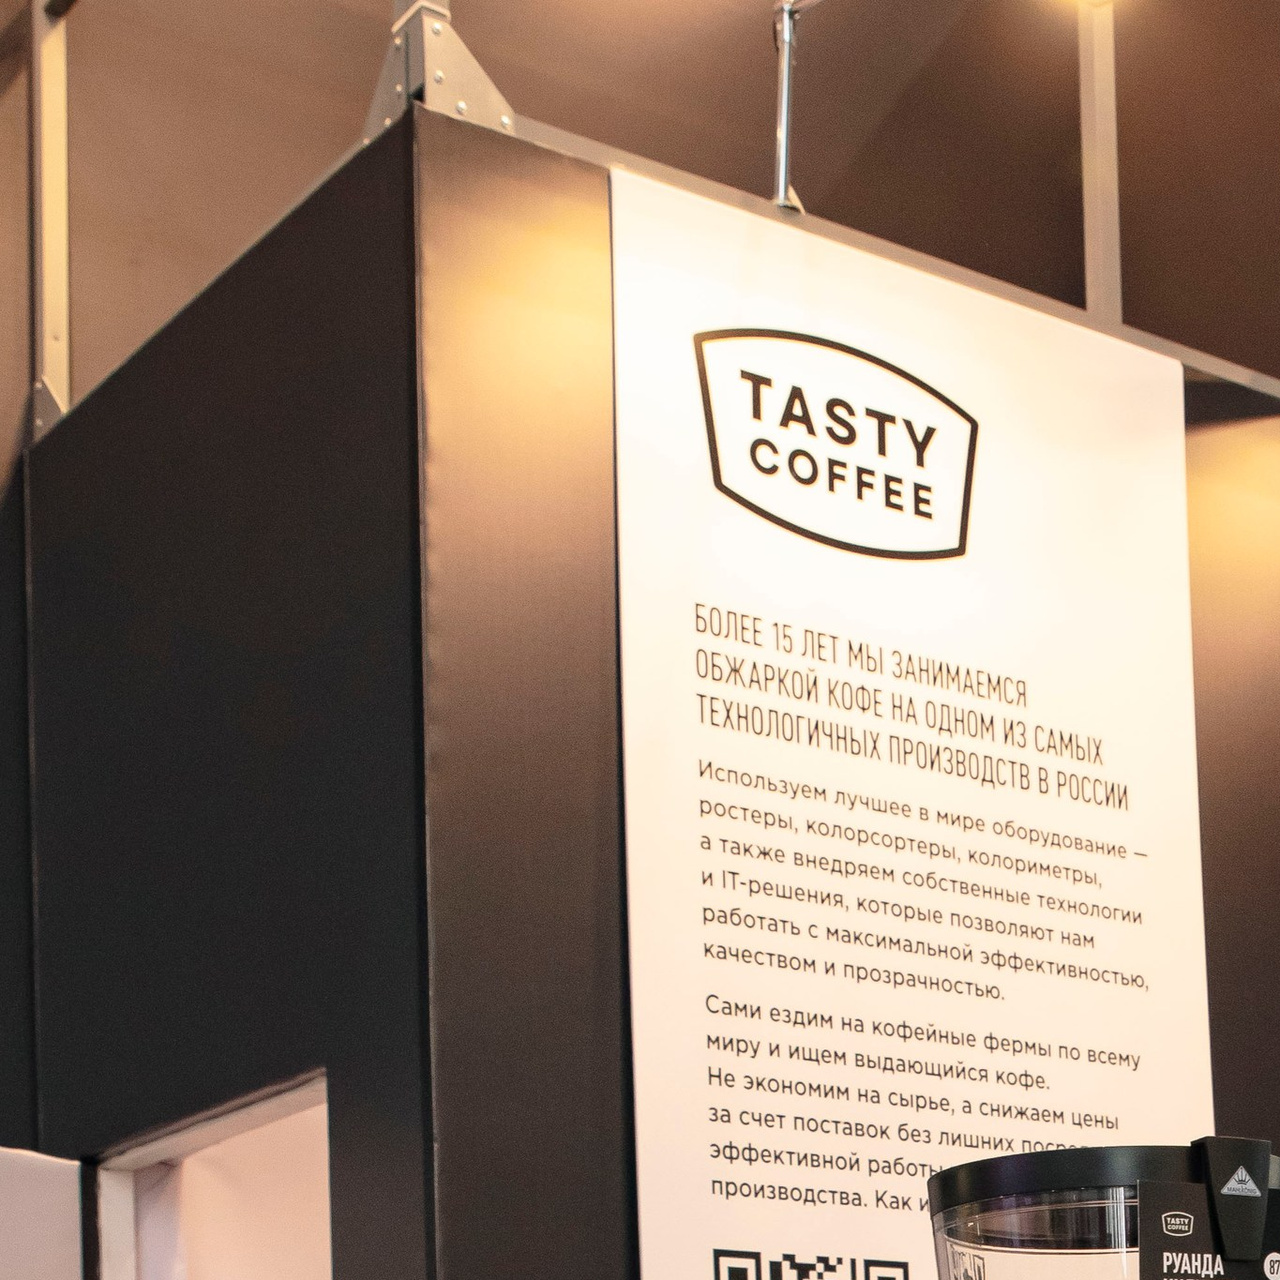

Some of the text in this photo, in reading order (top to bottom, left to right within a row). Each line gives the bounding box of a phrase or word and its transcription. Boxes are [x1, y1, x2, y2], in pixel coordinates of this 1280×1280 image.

[740, 369, 937, 468] TASTY
[749, 438, 933, 520] COFFEE
[695, 603, 1026, 707] БОЛЕЕ 15 ЛЕТ МЫ ЗАНИМАЕМСЯ
[696, 649, 1103, 765] ОБЖАРКОЙ КОФЕ НА ОДНОМ ИЗ САМЫХ
[696, 693, 1128, 811] ТЕХНОЛОГИЧНЫХ ПРОИЗВОДСТВ В РОССИИ
[699, 759, 826, 802] Используем
[834, 791, 911, 818] лучшее
[919, 807, 929, 821] в
[937, 811, 985, 832] мире
[992, 820, 1127, 859] оборудование
[700, 799, 1102, 888] ростеры, колорсортеры, колориметры,
[700, 835, 1142, 924] а также внедряем собственные технологии
[702, 870, 1094, 948] и IT-решения, которые позволяют нам
[703, 907, 1148, 991] работать с максимальной эффективностью,
[704, 943, 1004, 1000] качеством и прозрачностью.
[705, 994, 1140, 1072] Сами ездим на кофейные фермы по всему
[707, 1034, 1050, 1091] миру и ищем выдающийся кофе.
[708, 1066, 1118, 1130] Не экономим на сырье, а снижаем цены
[709, 1107, 731, 1123] за
[739, 1110, 786, 1129] счет
[793, 1116, 890, 1140] поставок
[898, 1123, 931, 1144] без
[938, 1131, 1014, 1152] лишних
[710, 1141, 860, 1172] эффективной
[711, 1180, 867, 1207] производства.
[875, 1190, 912, 1211] Как
[1166, 1217, 1190, 1226] TASTY
[1163, 1252, 1225, 1278] РУАНДА
[1269, 1260, 1280, 1275] 87
